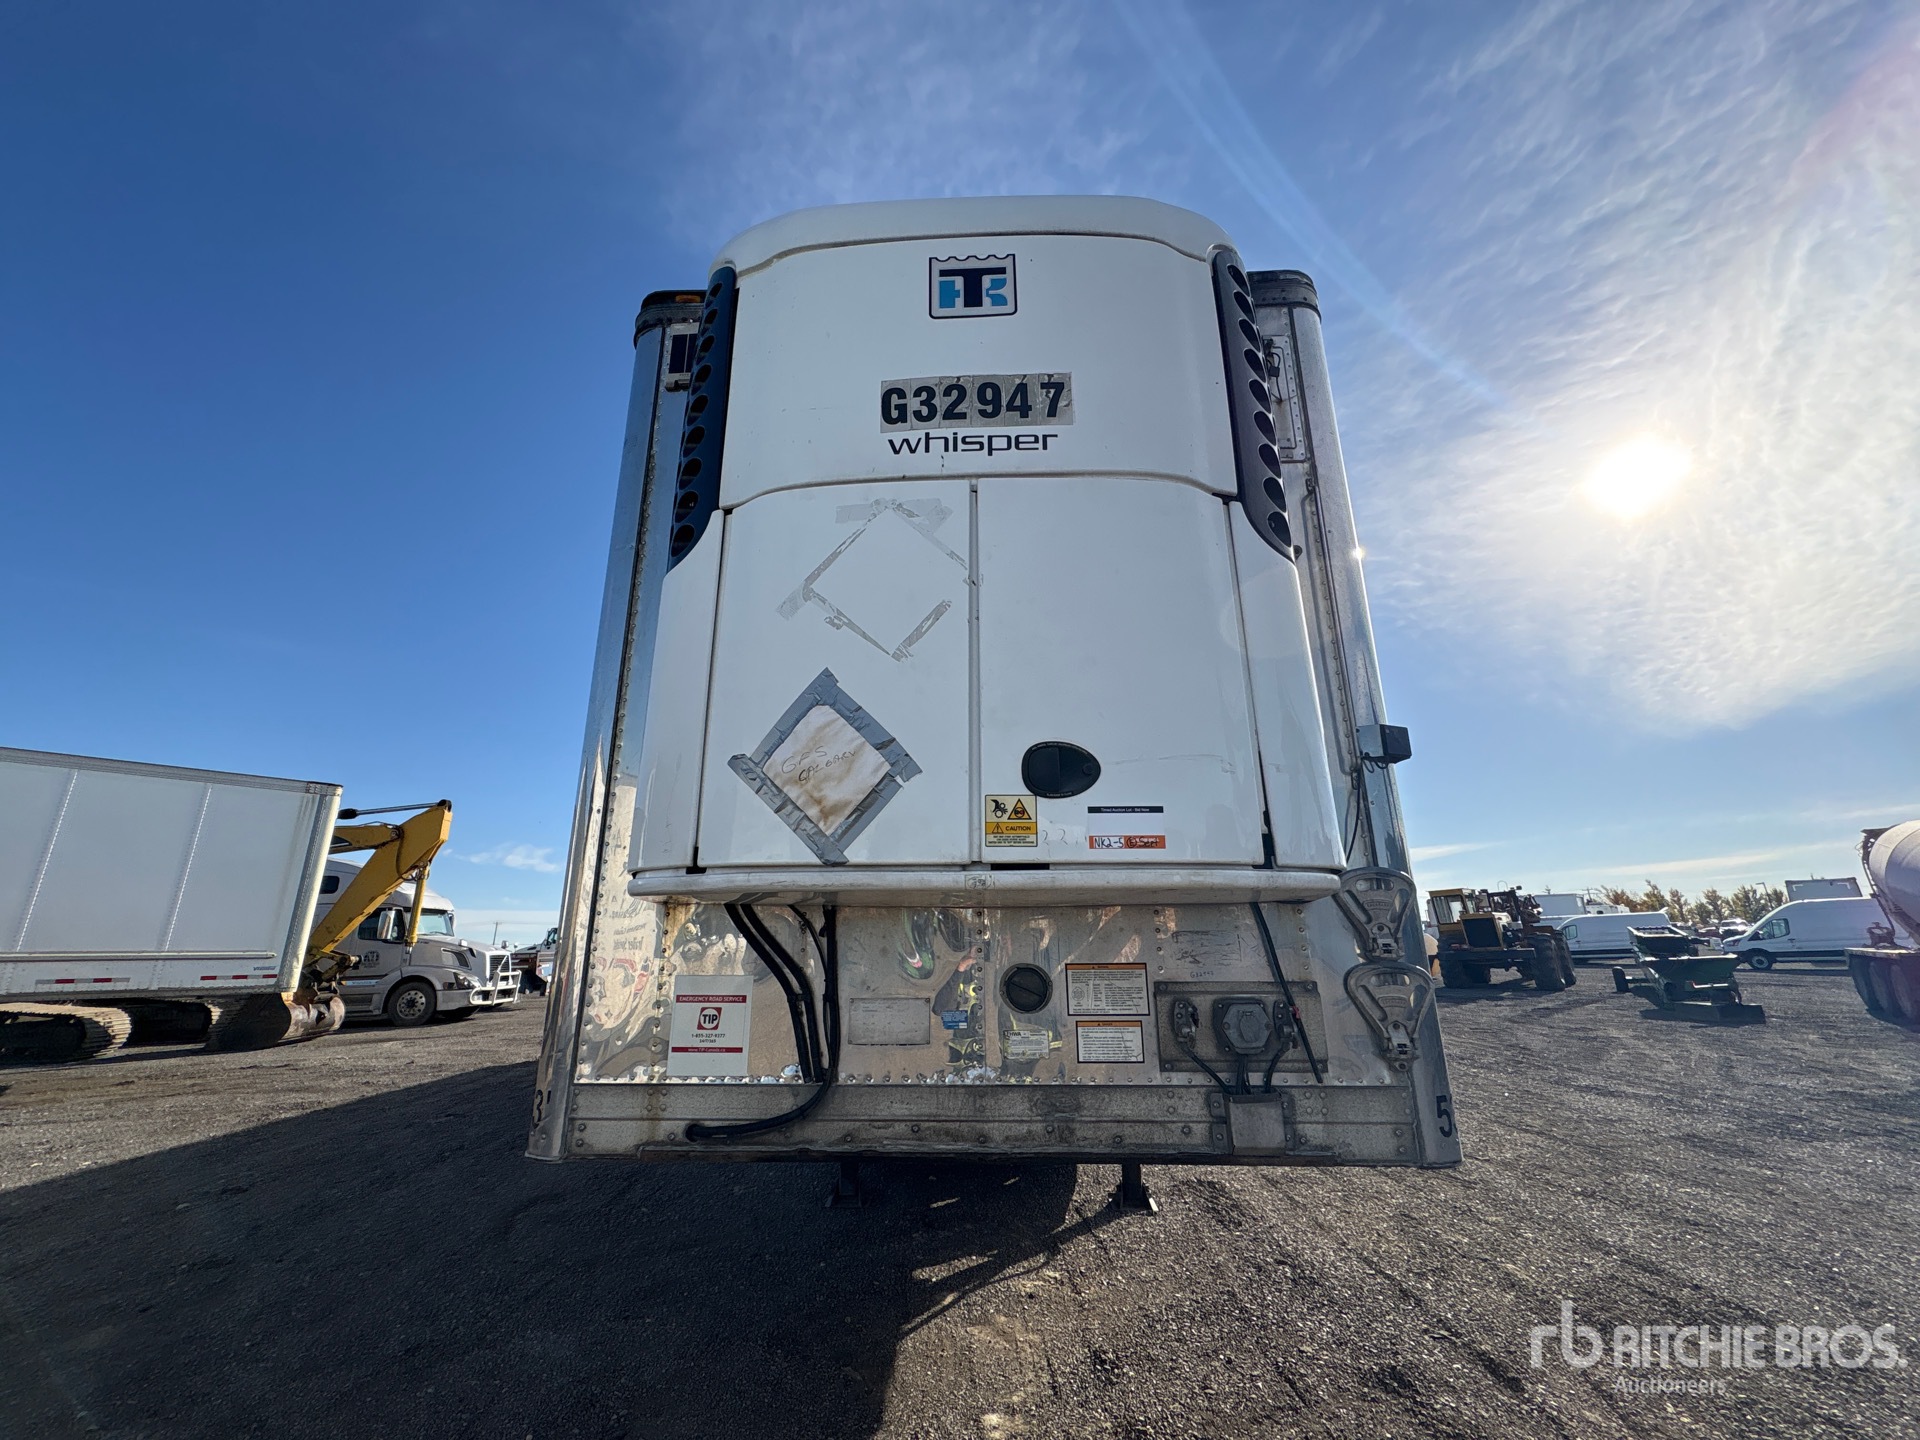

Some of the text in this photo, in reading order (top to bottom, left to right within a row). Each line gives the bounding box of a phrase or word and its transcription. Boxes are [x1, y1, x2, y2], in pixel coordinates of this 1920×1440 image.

[881, 381, 1065, 425] G32947
[887, 431, 1058, 456] whisper
[702, 1014, 718, 1024] TIP
